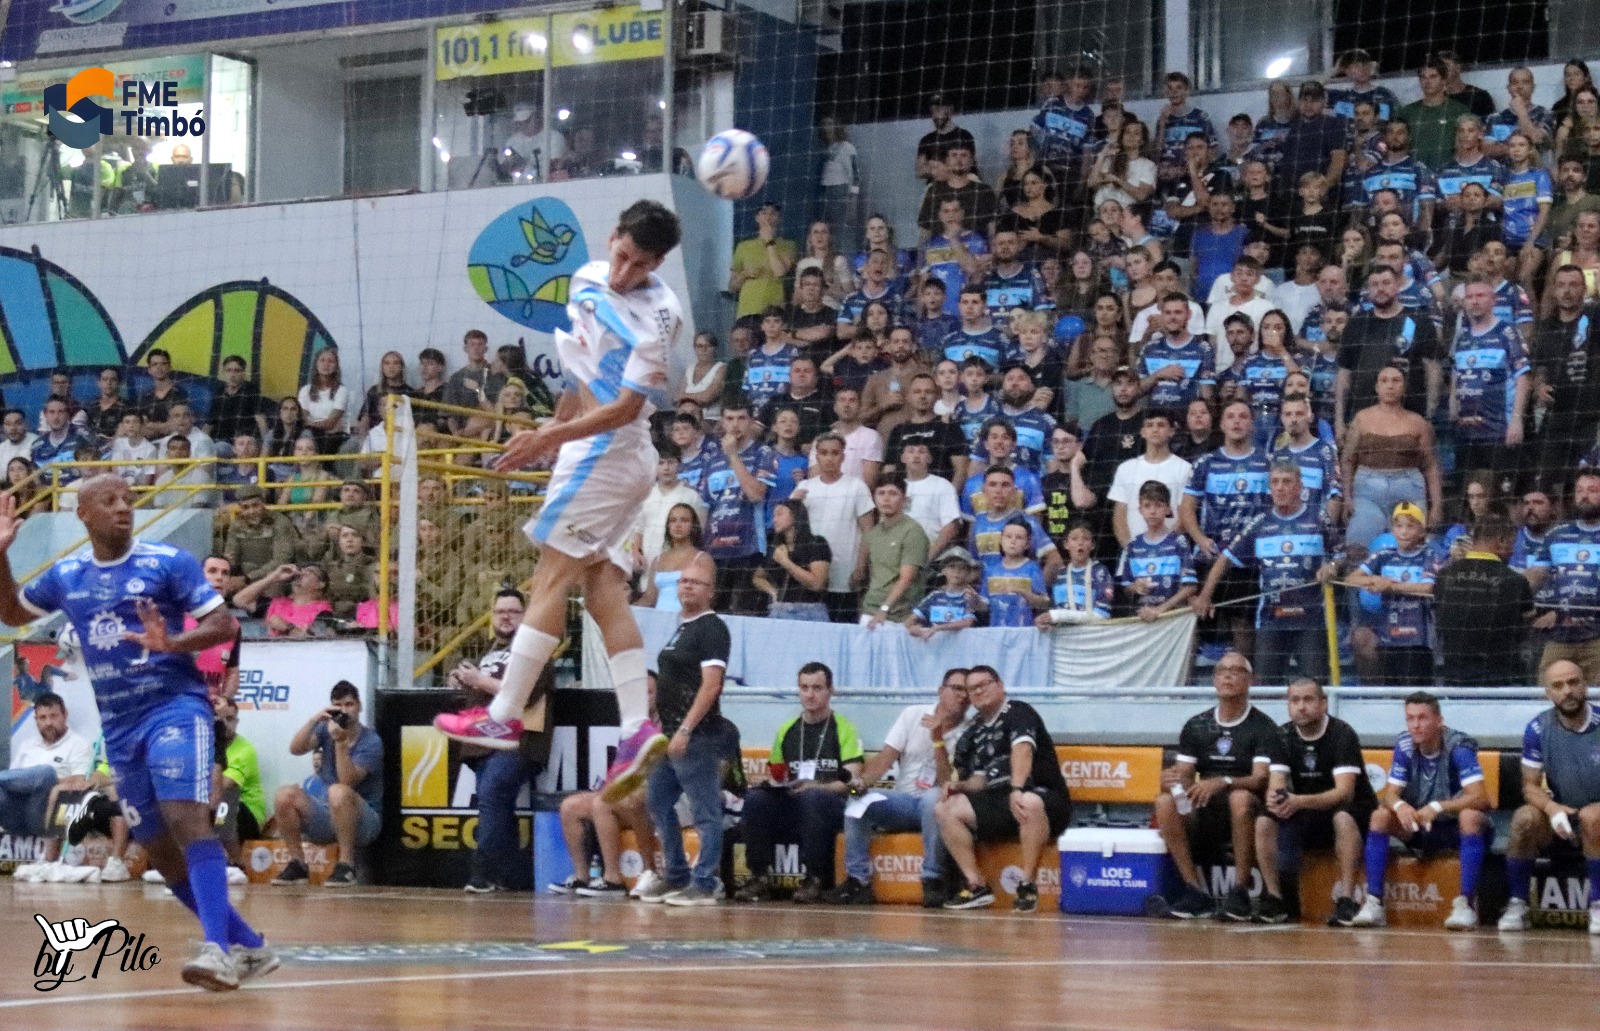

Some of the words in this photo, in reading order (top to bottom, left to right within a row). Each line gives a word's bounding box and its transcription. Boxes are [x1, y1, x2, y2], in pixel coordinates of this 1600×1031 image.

[238, 669, 264, 684] EIO
[233, 681, 290, 711] ERÃO
[1061, 761, 1132, 779] CENTRAL
[1102, 867, 1132, 879] LOES
[1122, 879, 1147, 889] CLUBE
